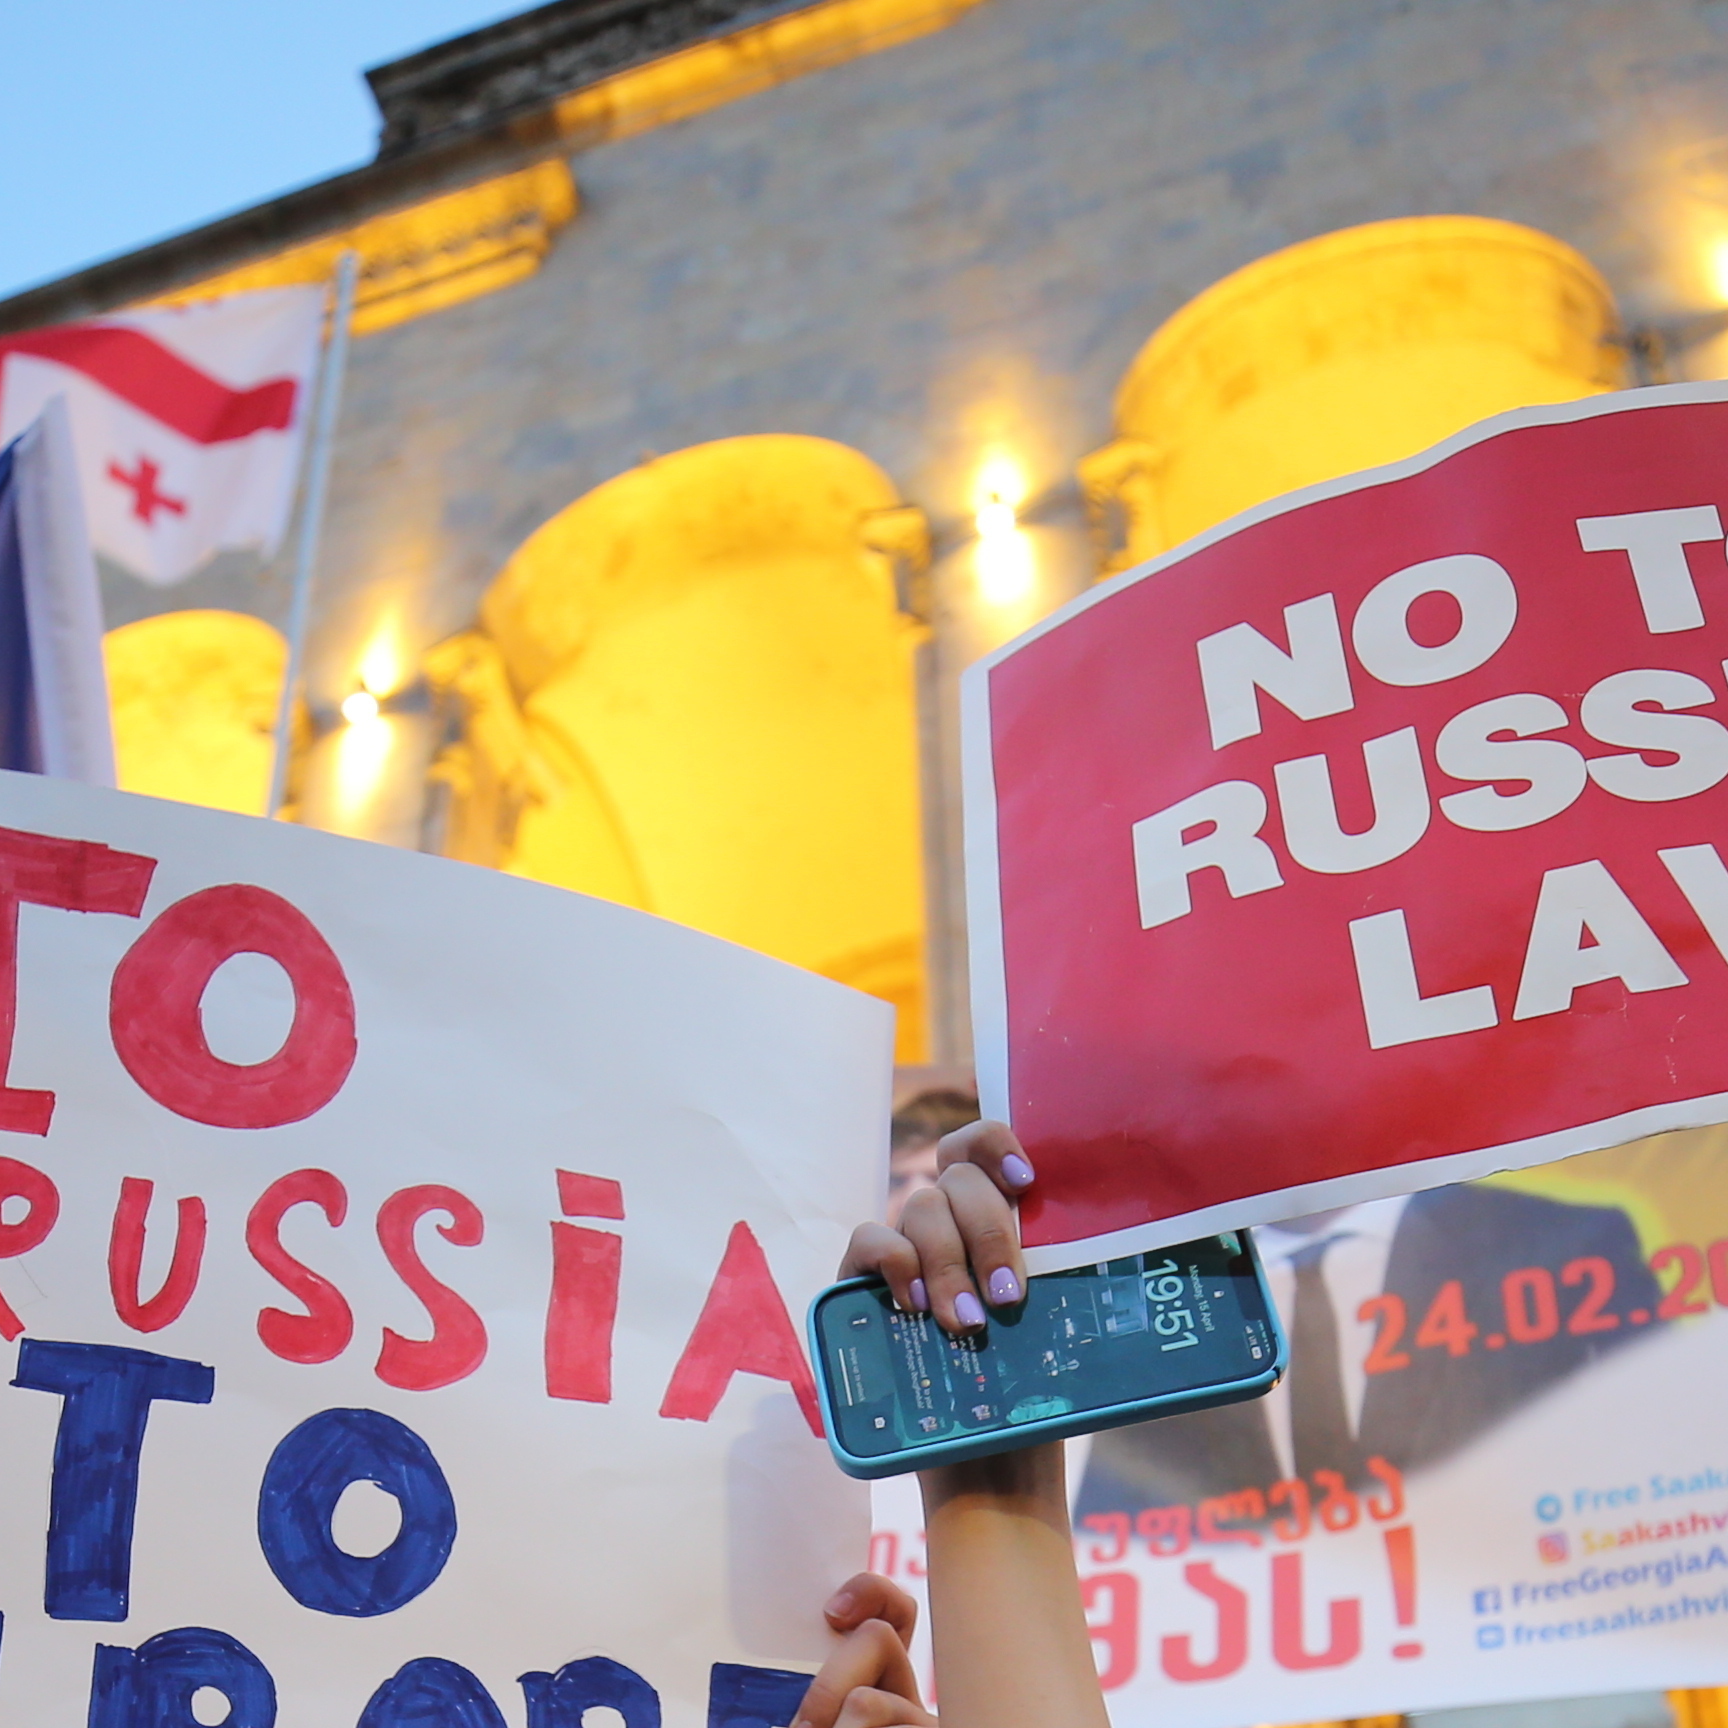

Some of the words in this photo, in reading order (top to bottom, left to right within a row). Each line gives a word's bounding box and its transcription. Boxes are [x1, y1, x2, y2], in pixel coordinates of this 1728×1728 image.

[1197, 553, 1518, 752] NO
[1188, 1264, 1204, 1300] Monday,
[1141, 1259, 1200, 1352] 19:51
[1197, 1299, 1210, 1312] 15
[1200, 1312, 1215, 1333] April
[11, 1338, 456, 1621] TO
[1572, 1486, 1641, 1517] Free
